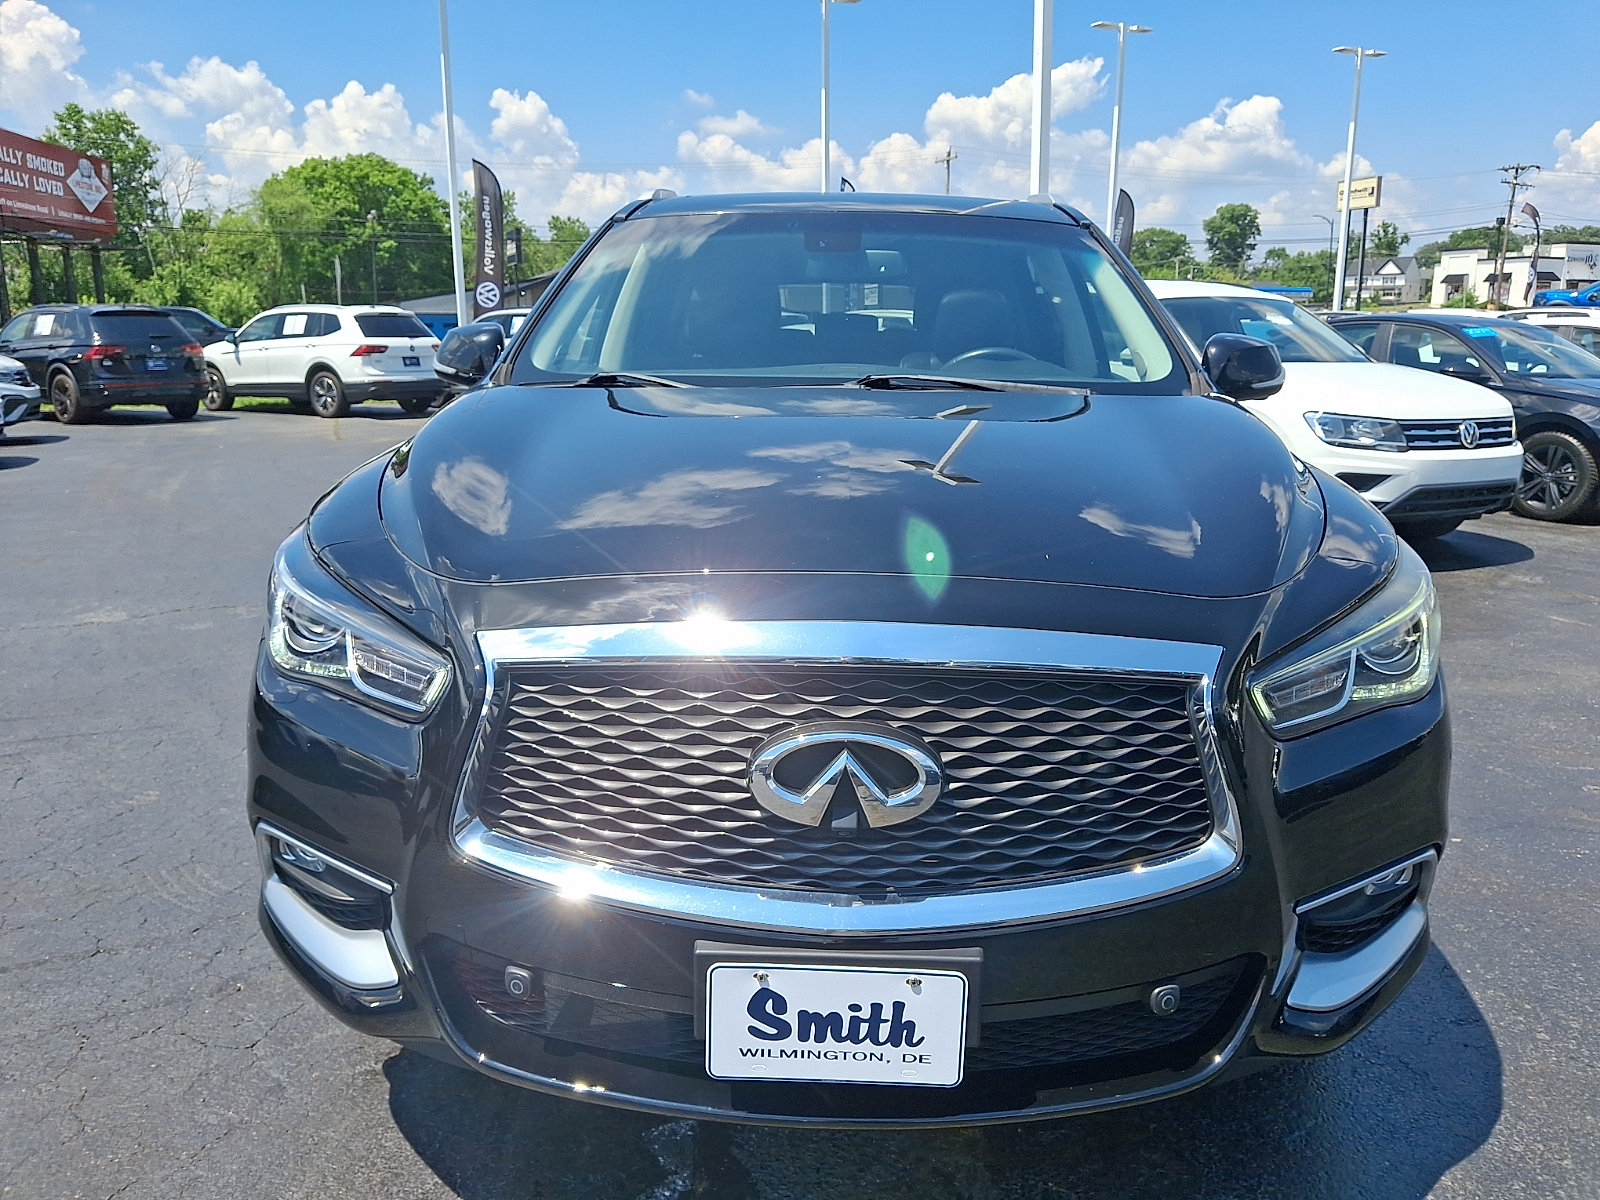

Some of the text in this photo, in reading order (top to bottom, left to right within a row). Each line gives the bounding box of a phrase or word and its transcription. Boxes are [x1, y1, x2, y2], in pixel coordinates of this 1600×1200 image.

[26, 153, 65, 177] SMOKED
[33, 175, 64, 197] LOVED
[747, 987, 925, 1047] Smith
[738, 1047, 932, 1065] WILMINGTON, DE
